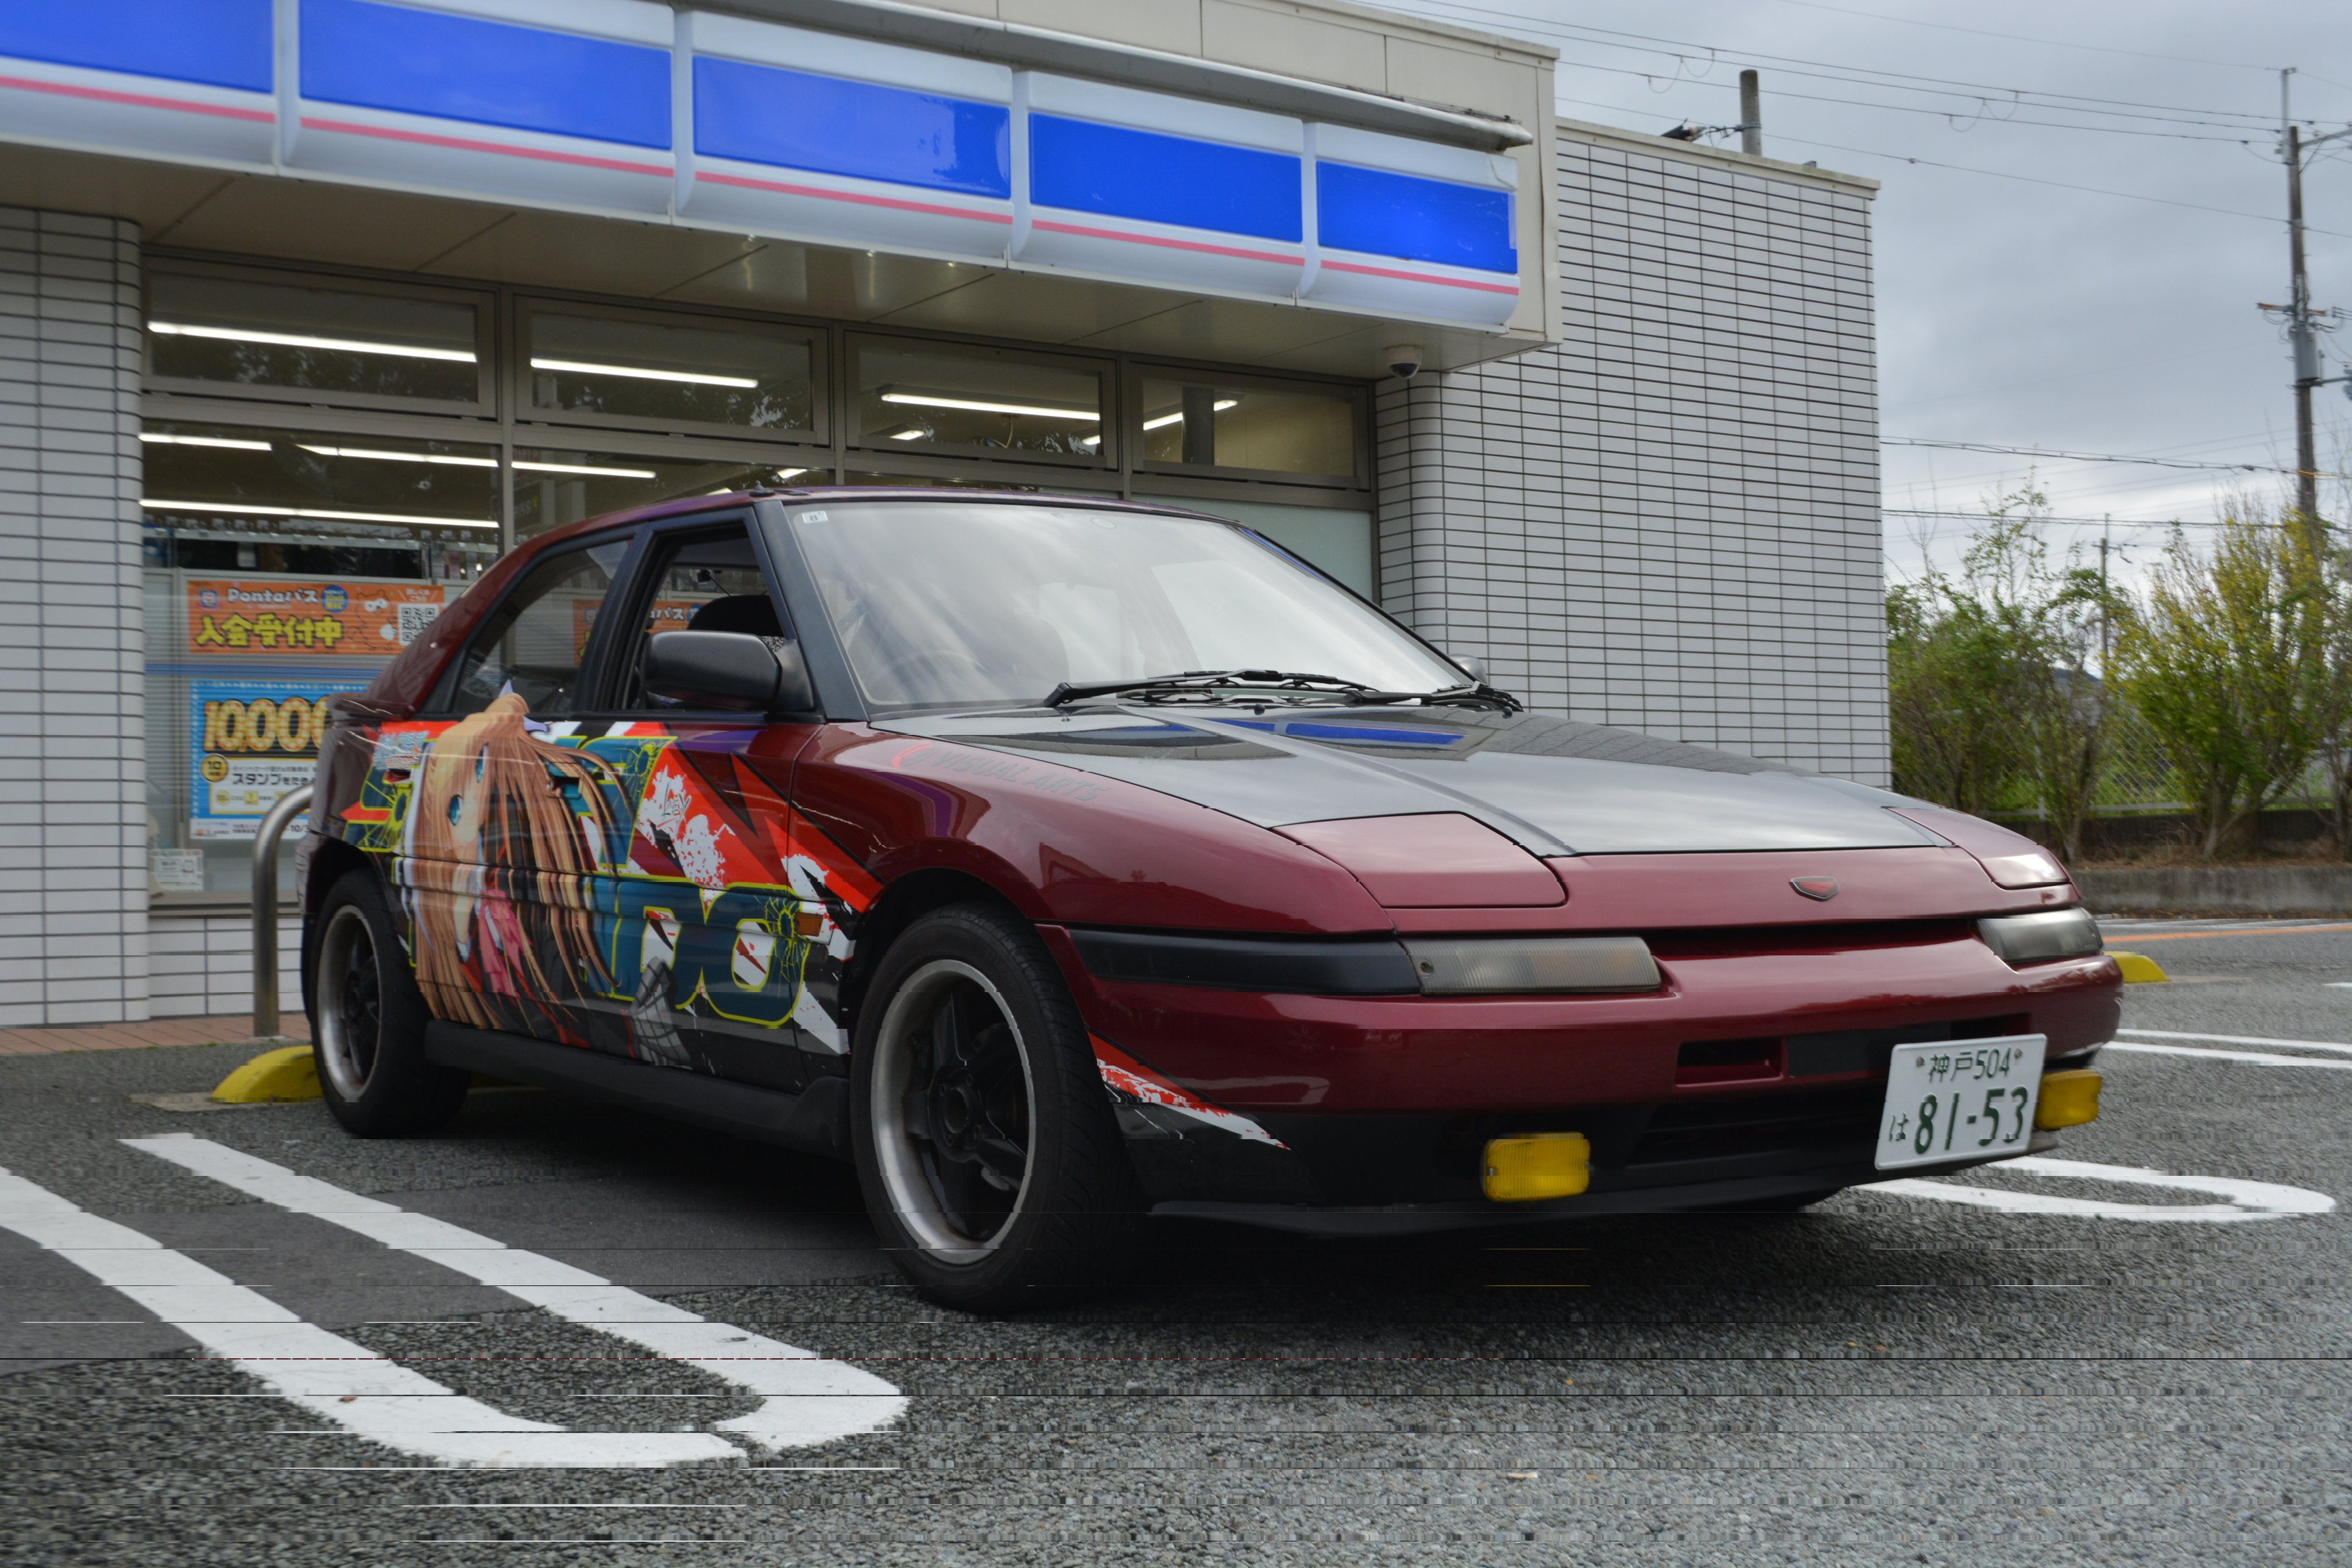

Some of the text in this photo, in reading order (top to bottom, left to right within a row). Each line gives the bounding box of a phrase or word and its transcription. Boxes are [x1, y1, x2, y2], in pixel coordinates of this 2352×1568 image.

[227, 587, 319, 603] Pontaパス
[195, 613, 344, 648] 入会受付中
[932, 750, 1112, 802] VISUAL ARTS
[1889, 1085, 2029, 1155] は 81-53
